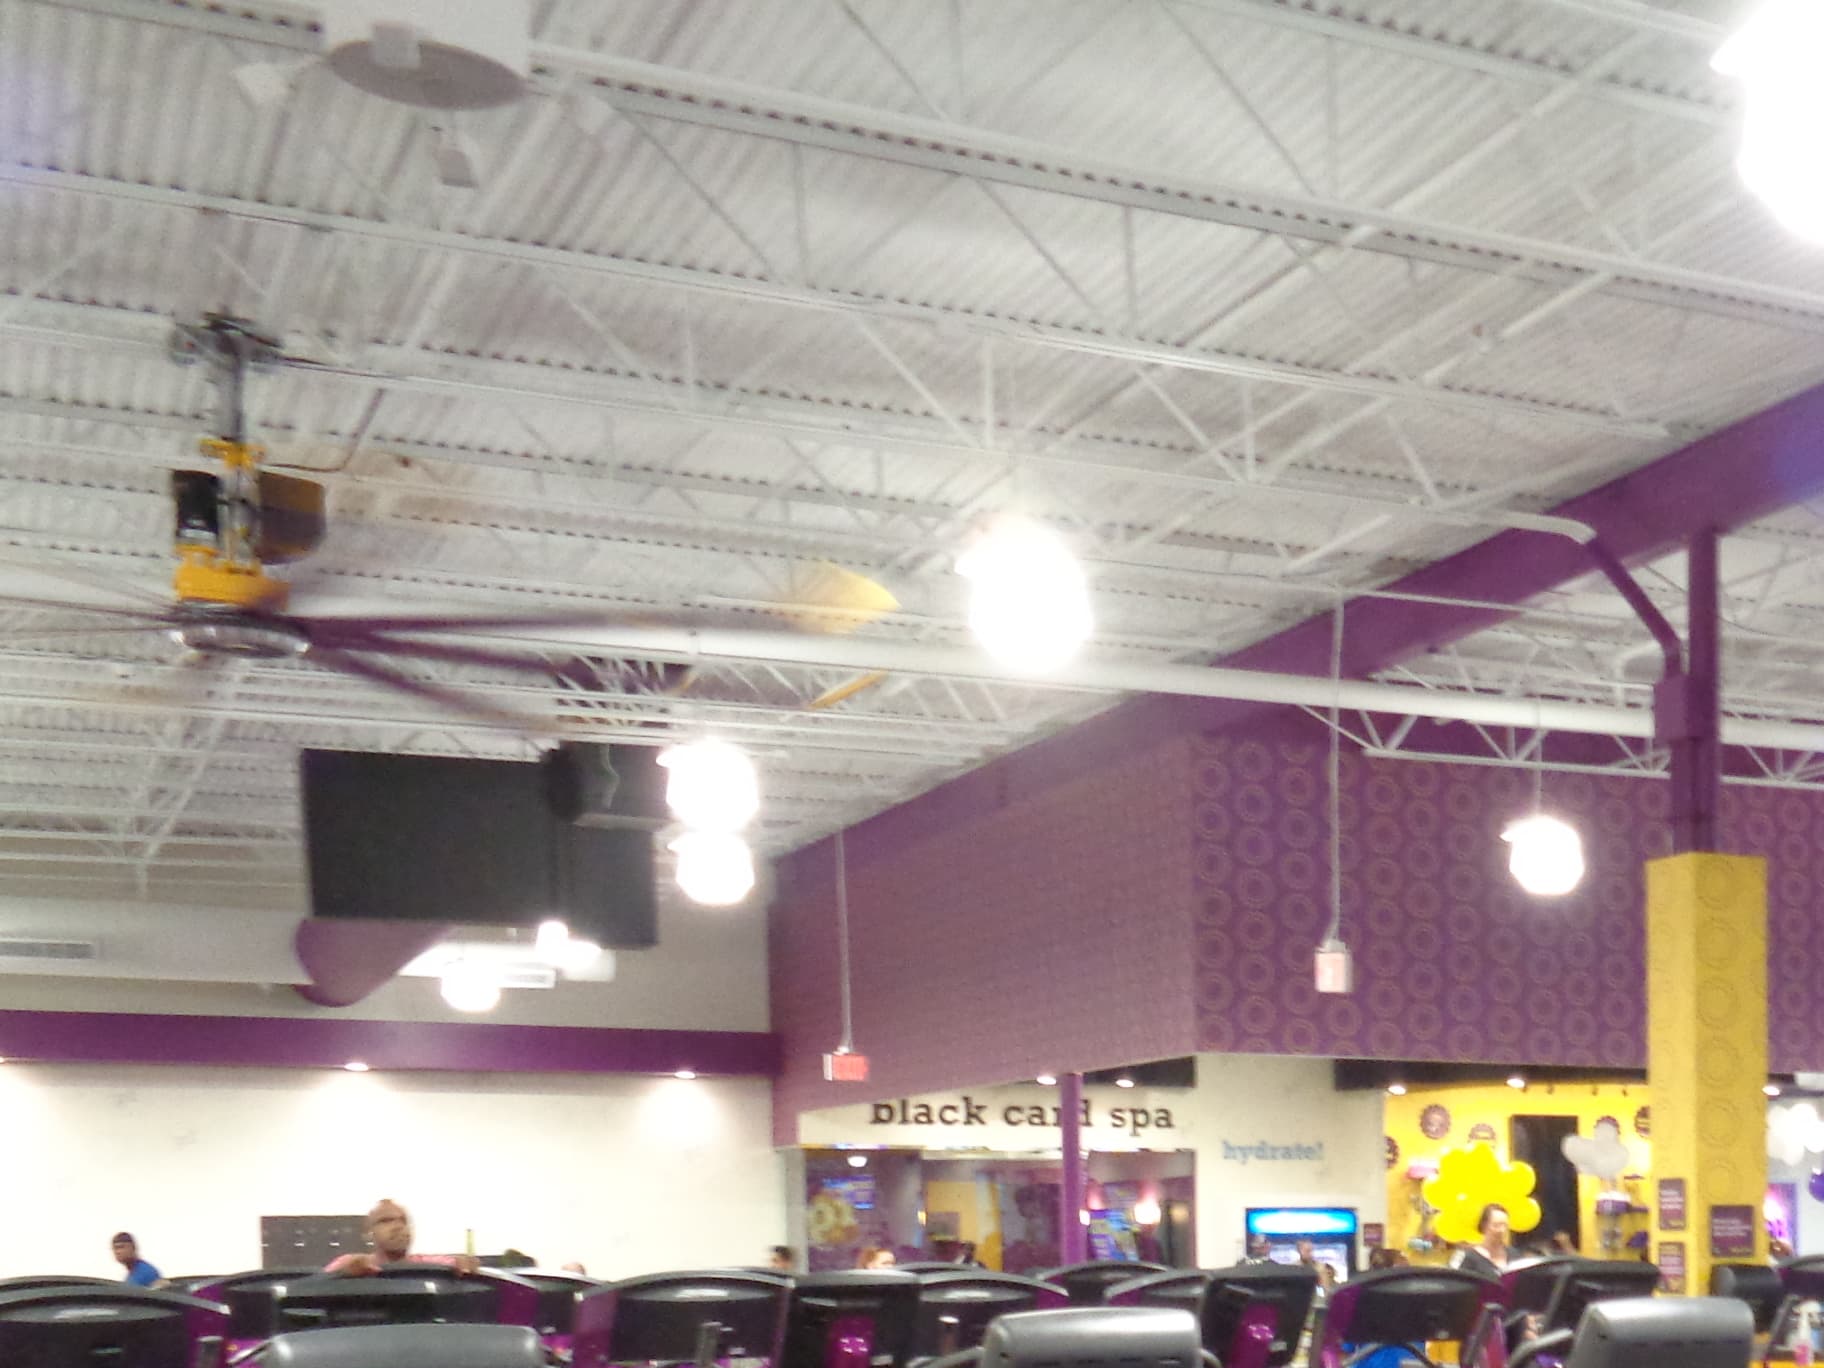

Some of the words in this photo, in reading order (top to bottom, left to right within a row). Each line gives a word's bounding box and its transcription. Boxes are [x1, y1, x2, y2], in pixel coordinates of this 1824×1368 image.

[869, 1096, 988, 1127] black
[1111, 1107, 1176, 1137] spa
[1222, 1140, 1324, 1165] hydrate!
